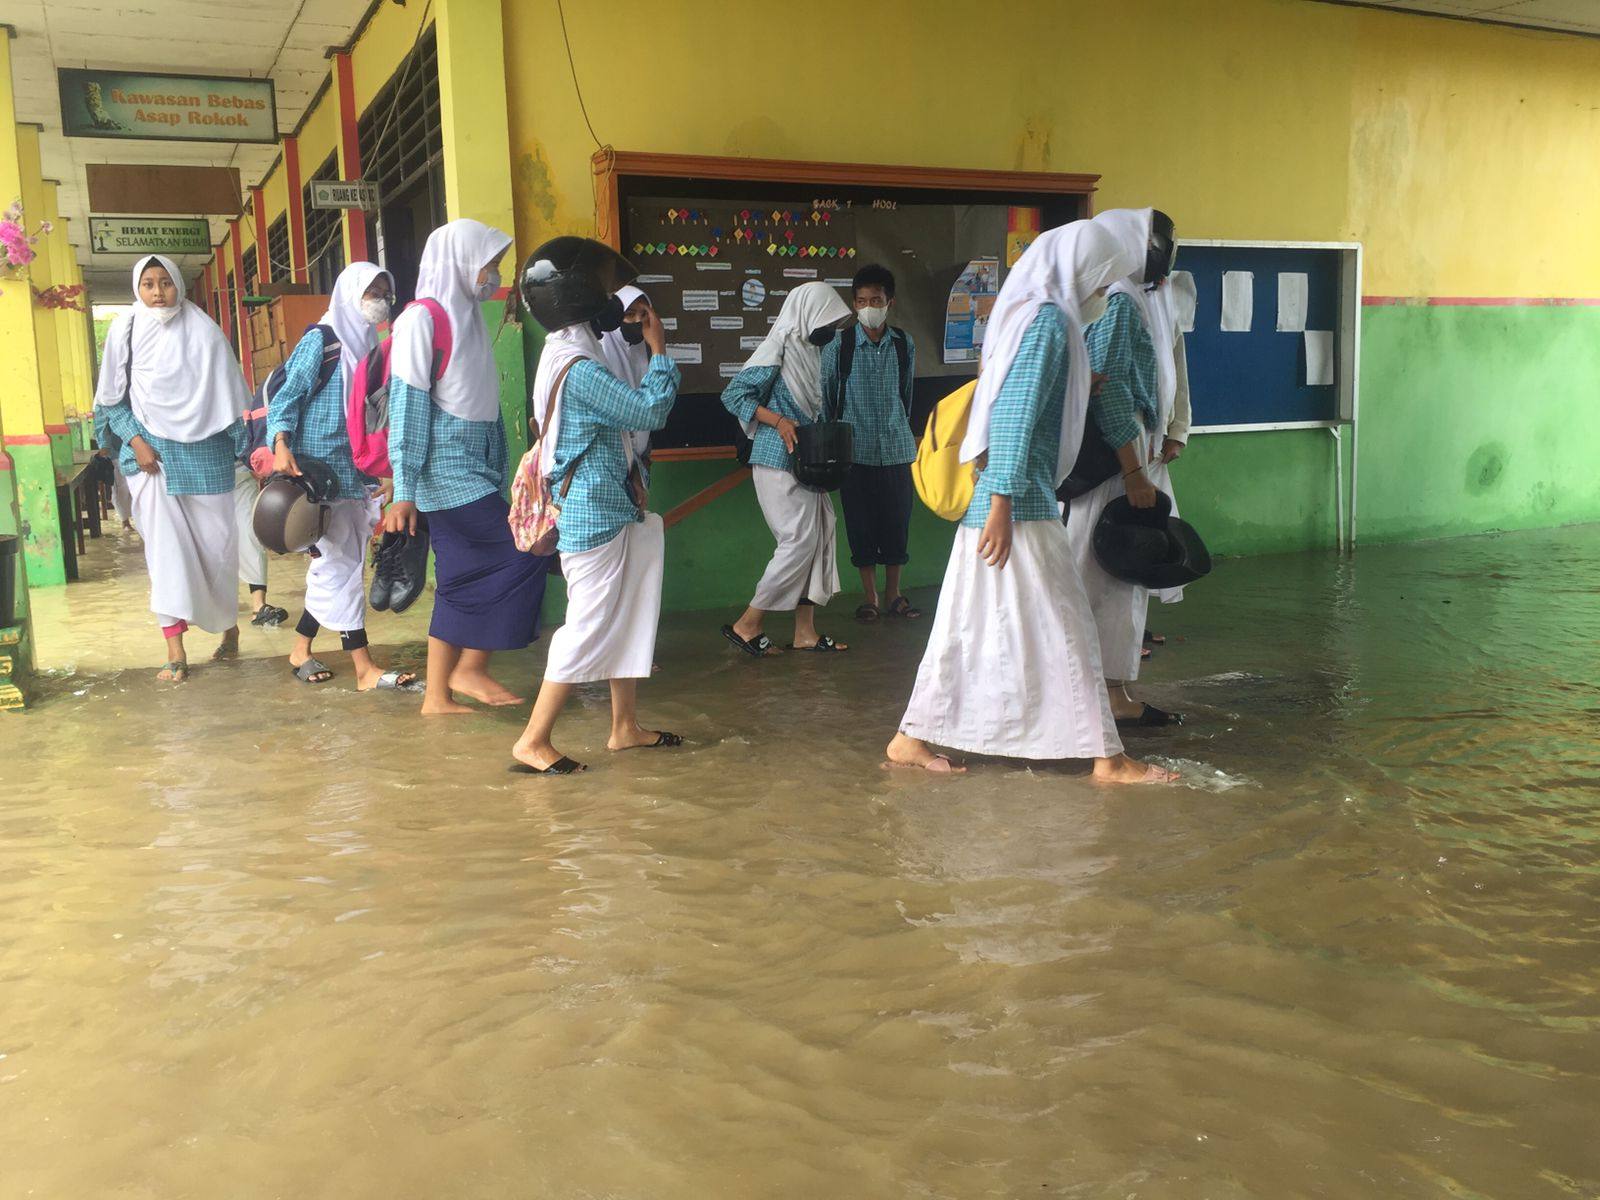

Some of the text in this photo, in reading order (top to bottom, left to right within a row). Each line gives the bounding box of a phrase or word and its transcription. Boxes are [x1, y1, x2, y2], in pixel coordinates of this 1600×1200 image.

[111, 88, 266, 110] Kawasan Bebas
[134, 108, 249, 127] Asap Rokok
[332, 188, 351, 202] RUANG
[121, 226, 201, 236] HEMAT ENERGI
[116, 237, 181, 247] SELAMATKAN
